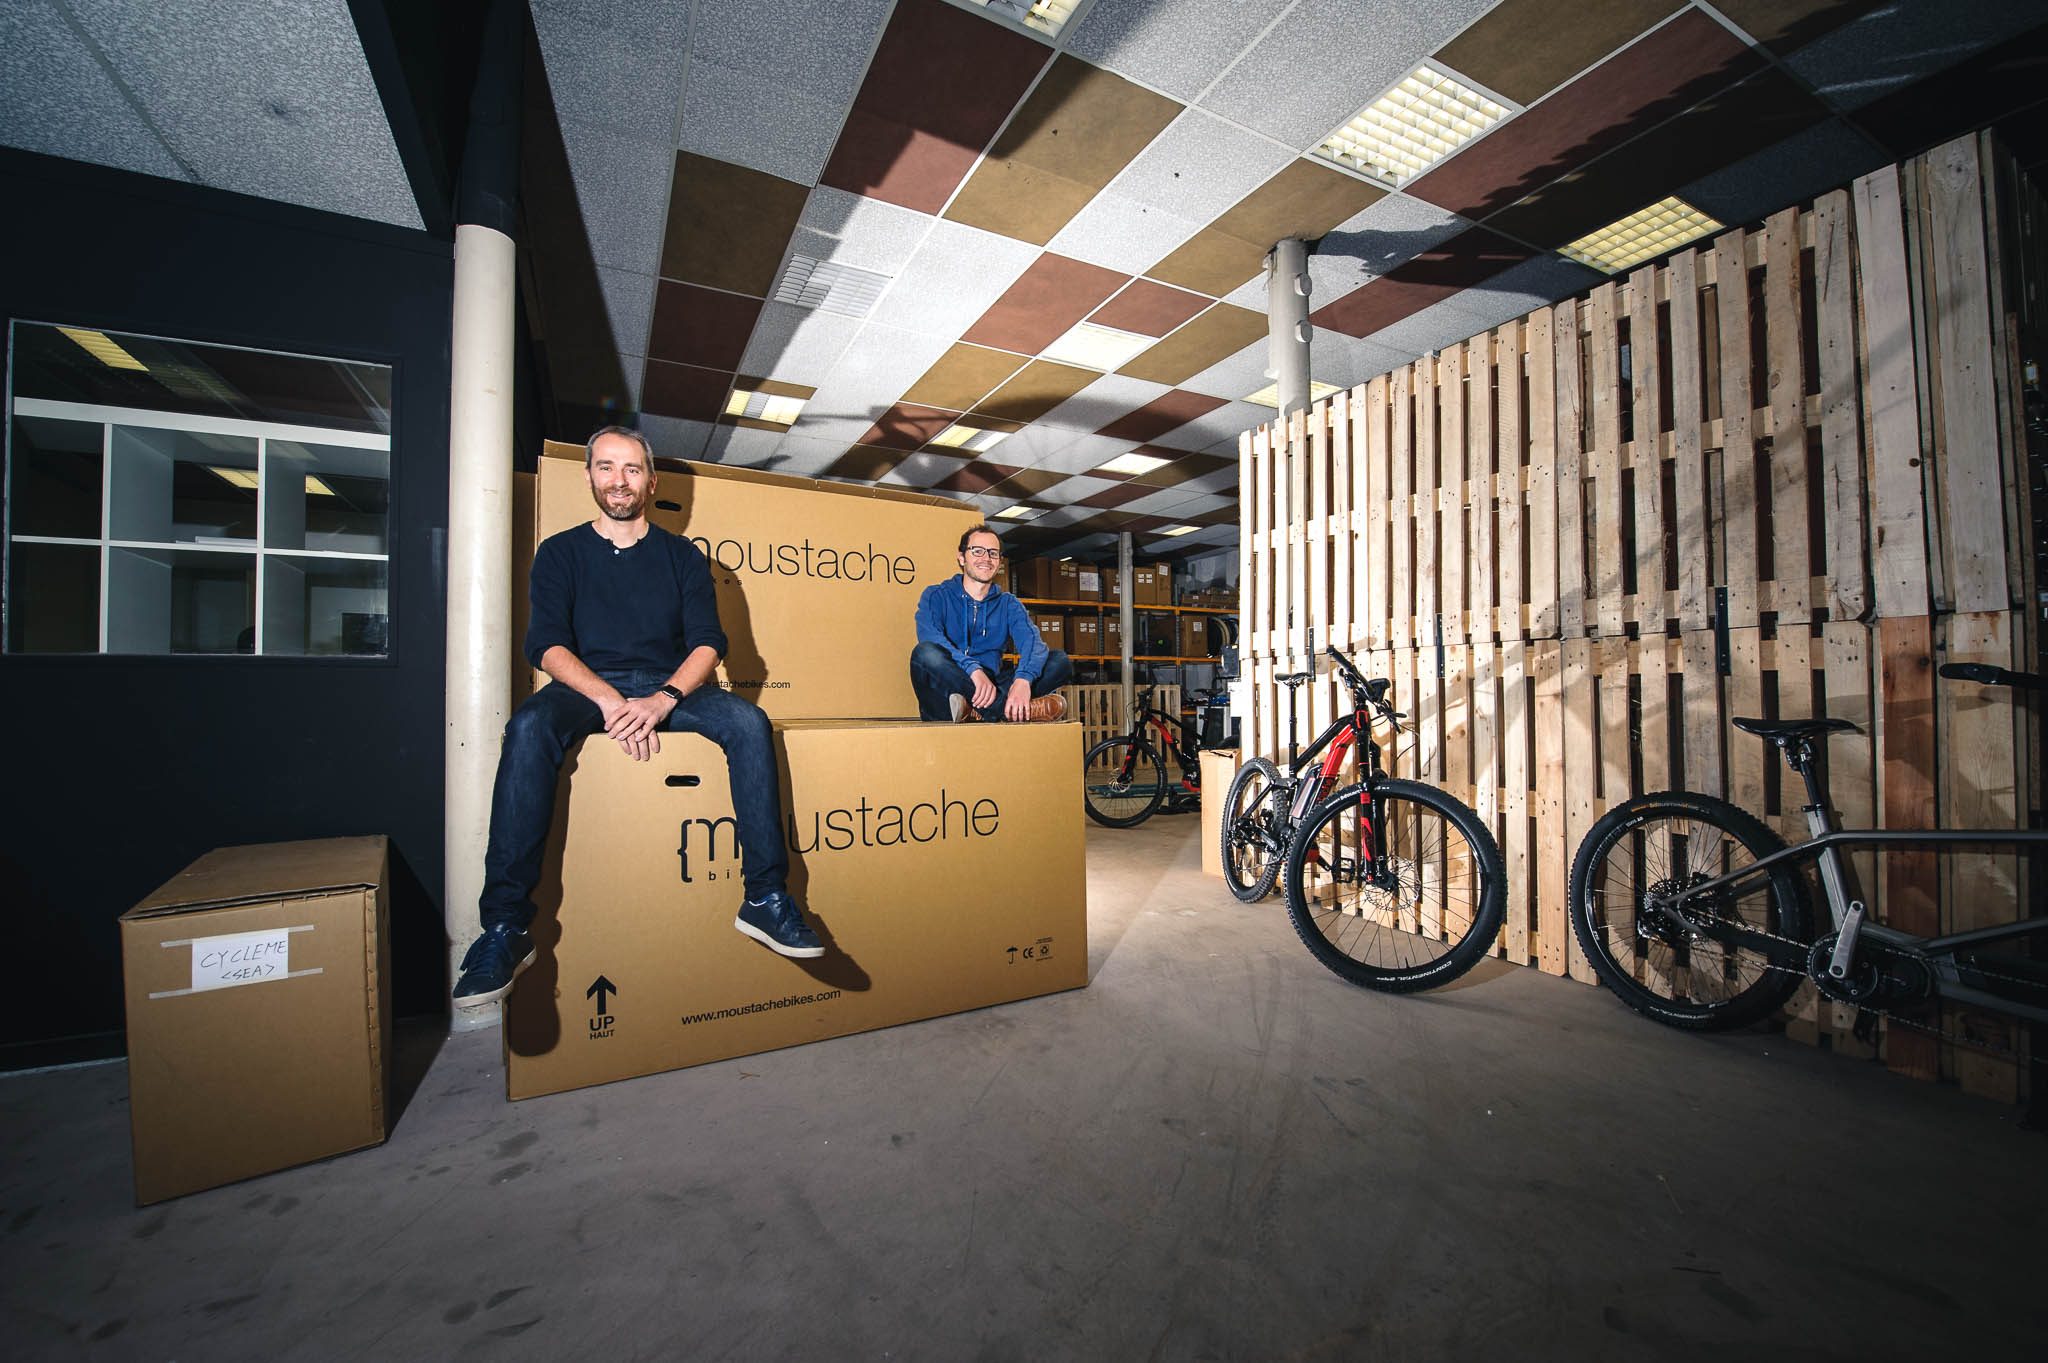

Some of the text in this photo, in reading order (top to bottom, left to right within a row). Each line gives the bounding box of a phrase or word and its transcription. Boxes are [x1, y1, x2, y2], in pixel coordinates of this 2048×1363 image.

[200, 940, 287, 968] CYCLEME
[681, 989, 841, 1025] www.moustachebikes.com
[589, 1015, 615, 1031] UP
[589, 1029, 615, 1040] HAUT
